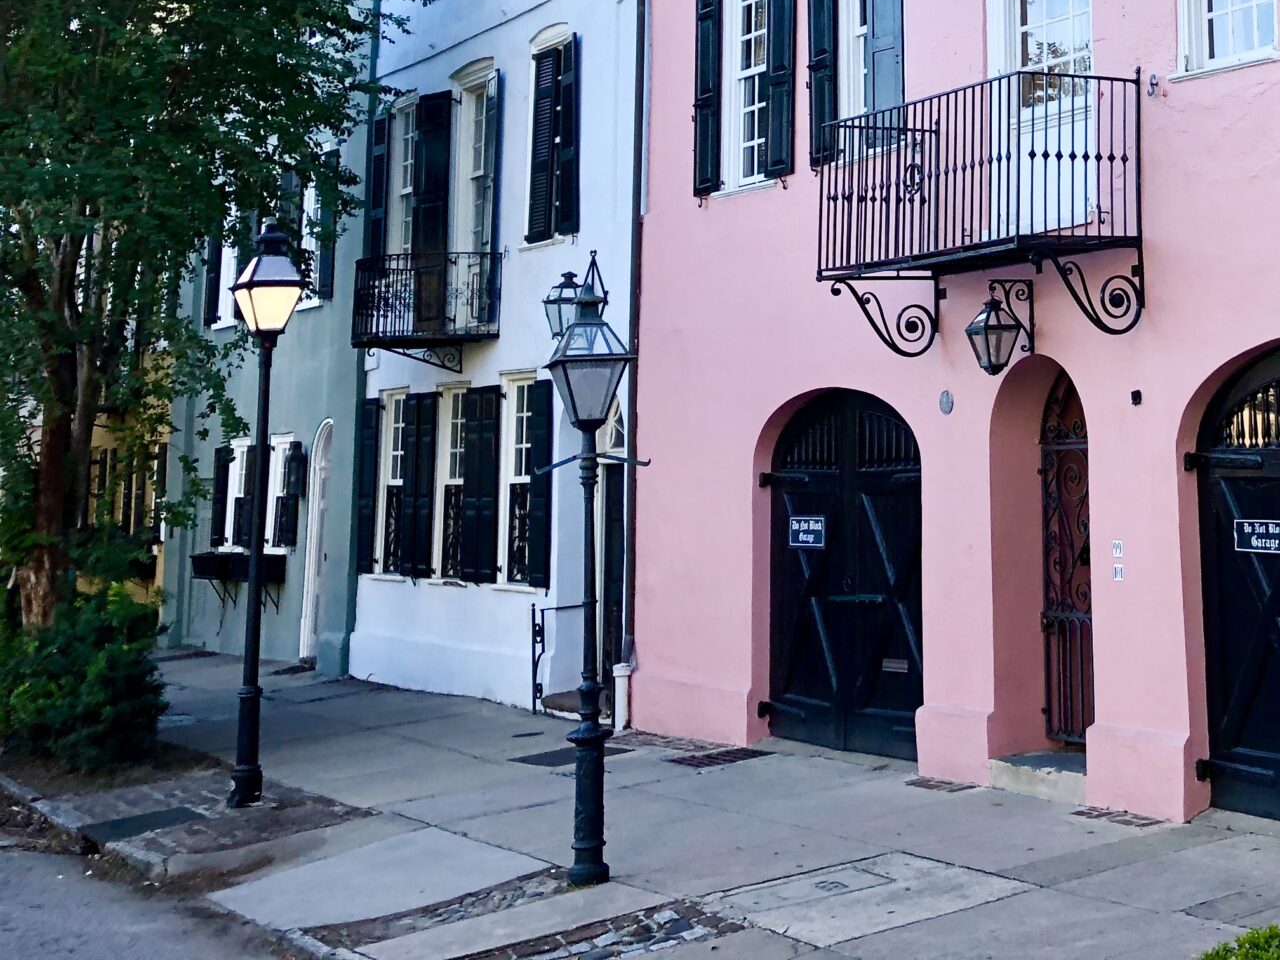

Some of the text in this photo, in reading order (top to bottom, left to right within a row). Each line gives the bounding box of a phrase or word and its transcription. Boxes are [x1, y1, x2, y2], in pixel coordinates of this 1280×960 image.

[1243, 523, 1252, 533] Do
[1254, 523, 1266, 534] Not
[1113, 541, 1122, 555] 99
[1251, 535, 1280, 550] Garage
